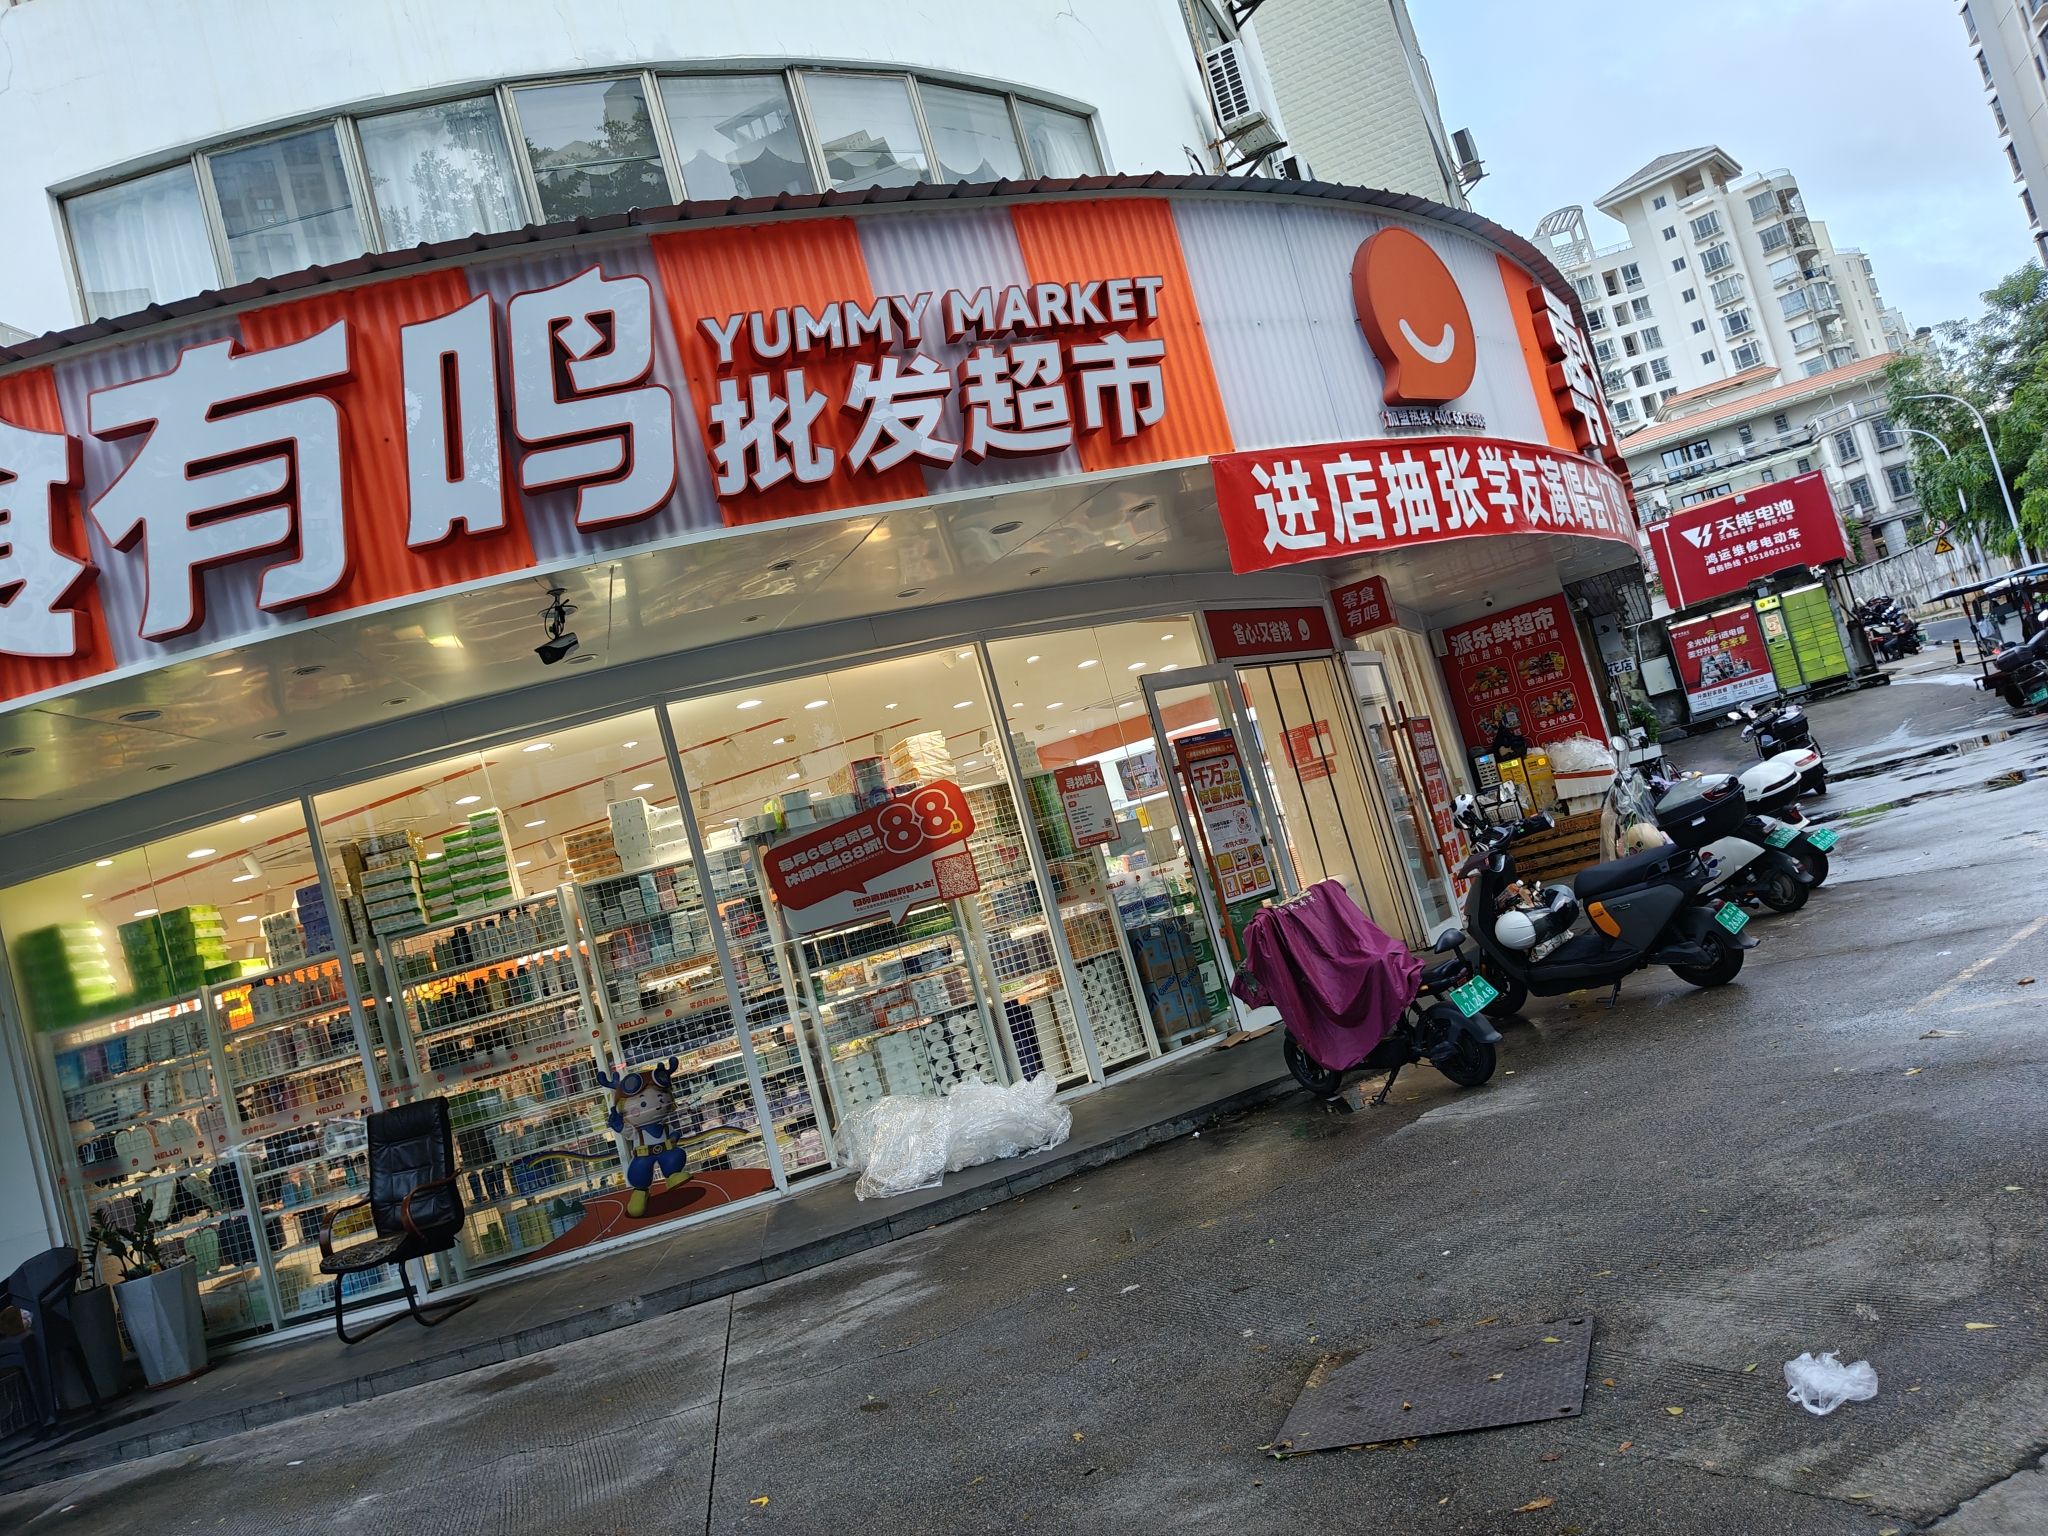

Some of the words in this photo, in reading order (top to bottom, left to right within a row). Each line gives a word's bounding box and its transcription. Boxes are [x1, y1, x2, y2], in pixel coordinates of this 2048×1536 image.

[700, 291, 933, 368] YUMMY
[944, 275, 1164, 342] MARKET
[709, 333, 1166, 497] 批发超市
[1716, 499, 1795, 535] 天能电池
[1704, 528, 1801, 566] 鸿运维修电动车
[1744, 541, 1802, 564] 13518021516
[1342, 586, 1375, 609] 零食
[1347, 604, 1381, 627] 有鸣
[1450, 607, 1555, 657] 派乐鲜超市
[877, 788, 958, 854] 88
[617, 1016, 648, 1031] HELLO!
[315, 1101, 345, 1116] HELLO!
[153, 1147, 182, 1161] HELLO!
